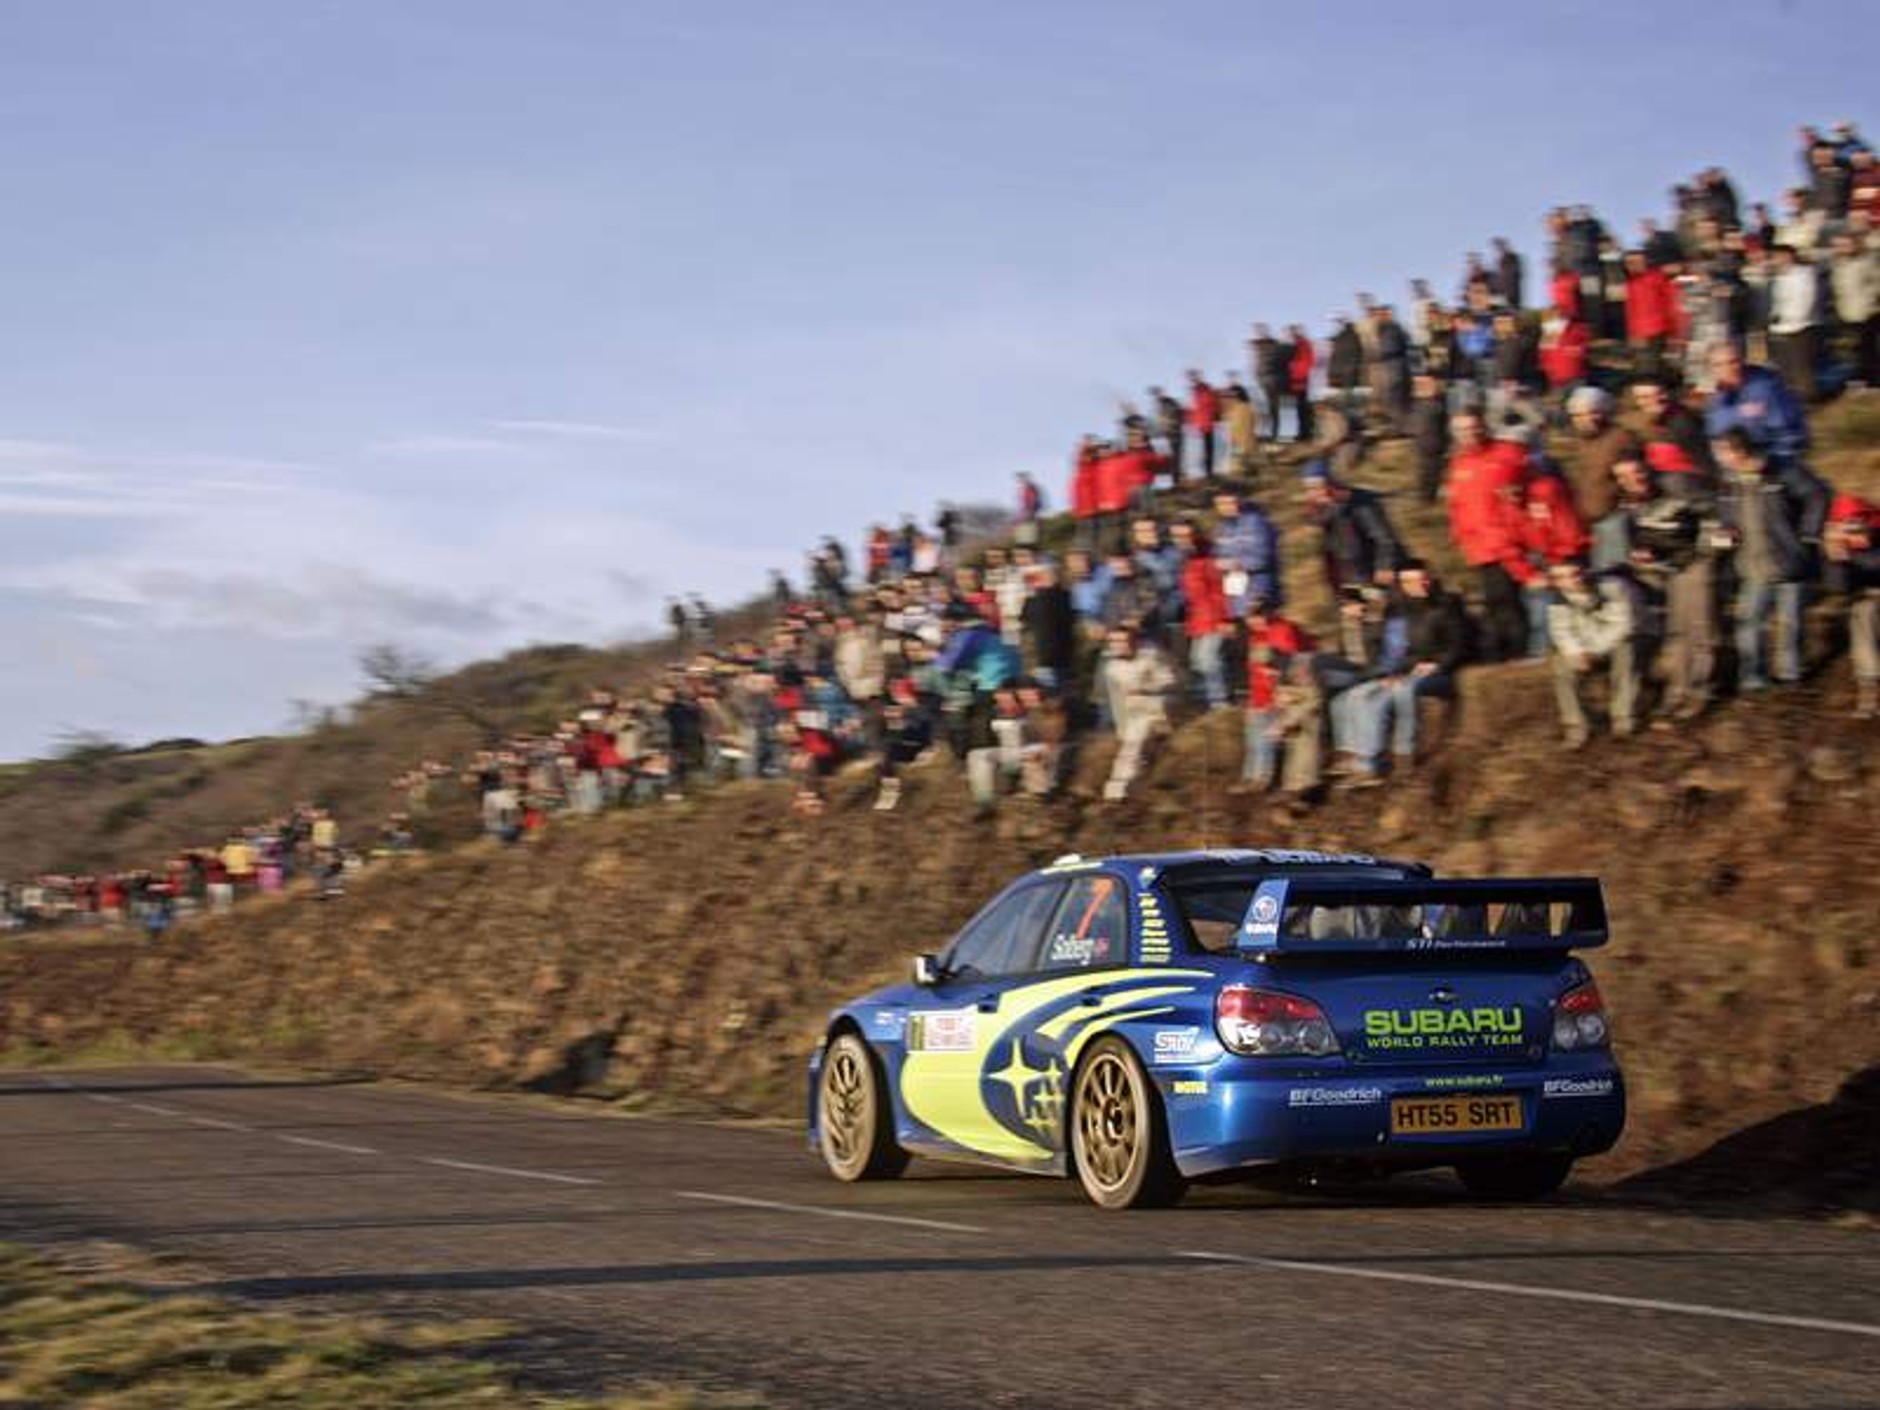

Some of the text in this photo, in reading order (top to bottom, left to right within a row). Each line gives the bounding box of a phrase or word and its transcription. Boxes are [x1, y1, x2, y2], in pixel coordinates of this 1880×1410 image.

[1076, 877, 1114, 939] 7
[1364, 1007, 1523, 1036] SUBARU
[1367, 1033, 1523, 1049] WORLD RALLY TEAM
[1288, 1087, 1382, 1103] BFGoodrich
[1542, 1079, 1614, 1094] BFGoodrich
[1397, 1101, 1514, 1127] HT55 SRT
